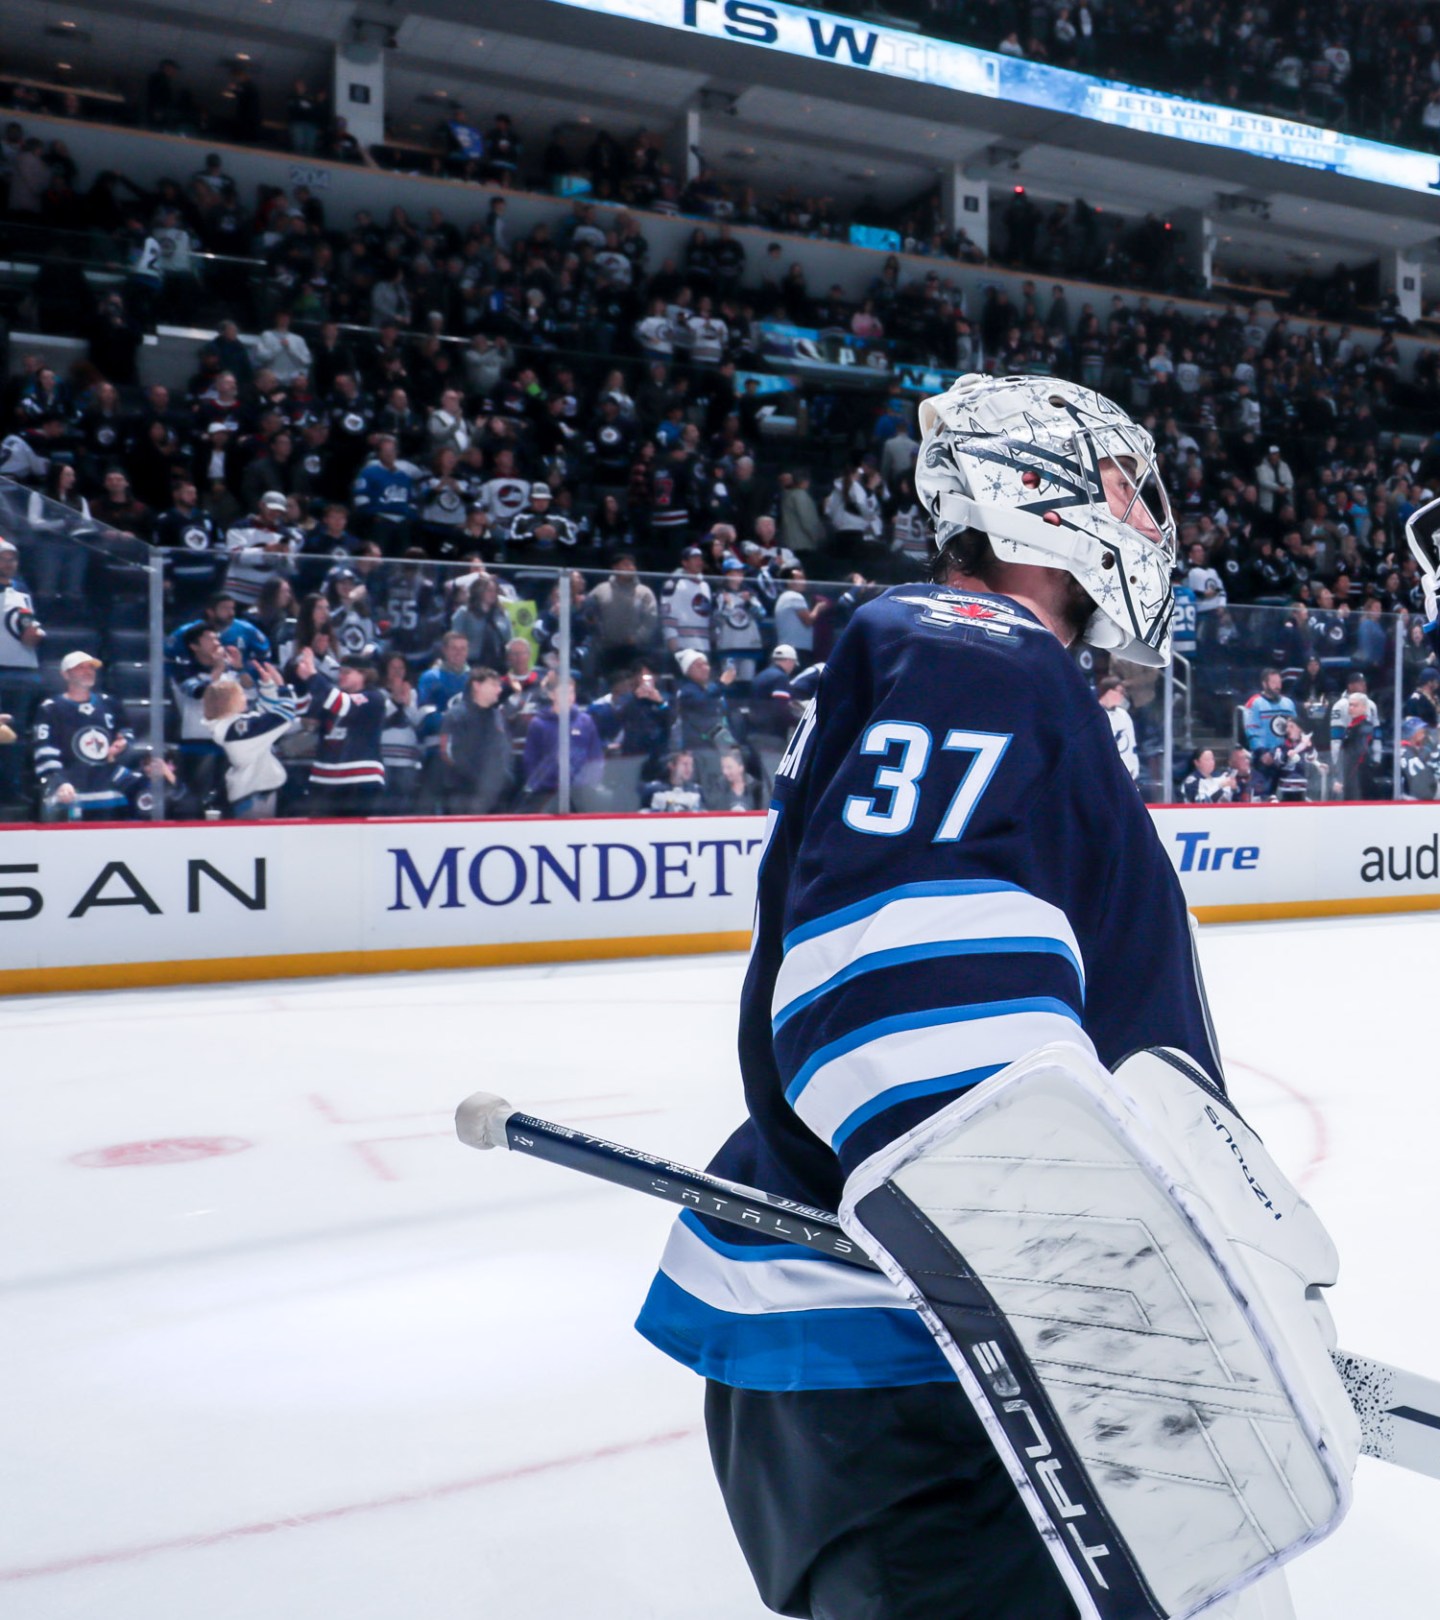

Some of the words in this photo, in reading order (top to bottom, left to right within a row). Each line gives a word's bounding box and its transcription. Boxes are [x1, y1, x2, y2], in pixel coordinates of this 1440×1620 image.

[1115, 94, 1164, 116] JETS
[1169, 104, 1218, 123] WIN!
[1228, 114, 1273, 133] JETS
[1278, 122, 1323, 142] WIN!
[387, 600, 418, 630] 55
[944, 595, 1011, 612] WINNIPEG
[952, 617, 989, 628] JETS
[1172, 605, 1196, 631] 29
[842, 720, 1014, 843] 37
[1175, 831, 1260, 872] Tire
[651, 1178, 874, 1261] CATALYS
[972, 1340, 1111, 1591] TRUE
